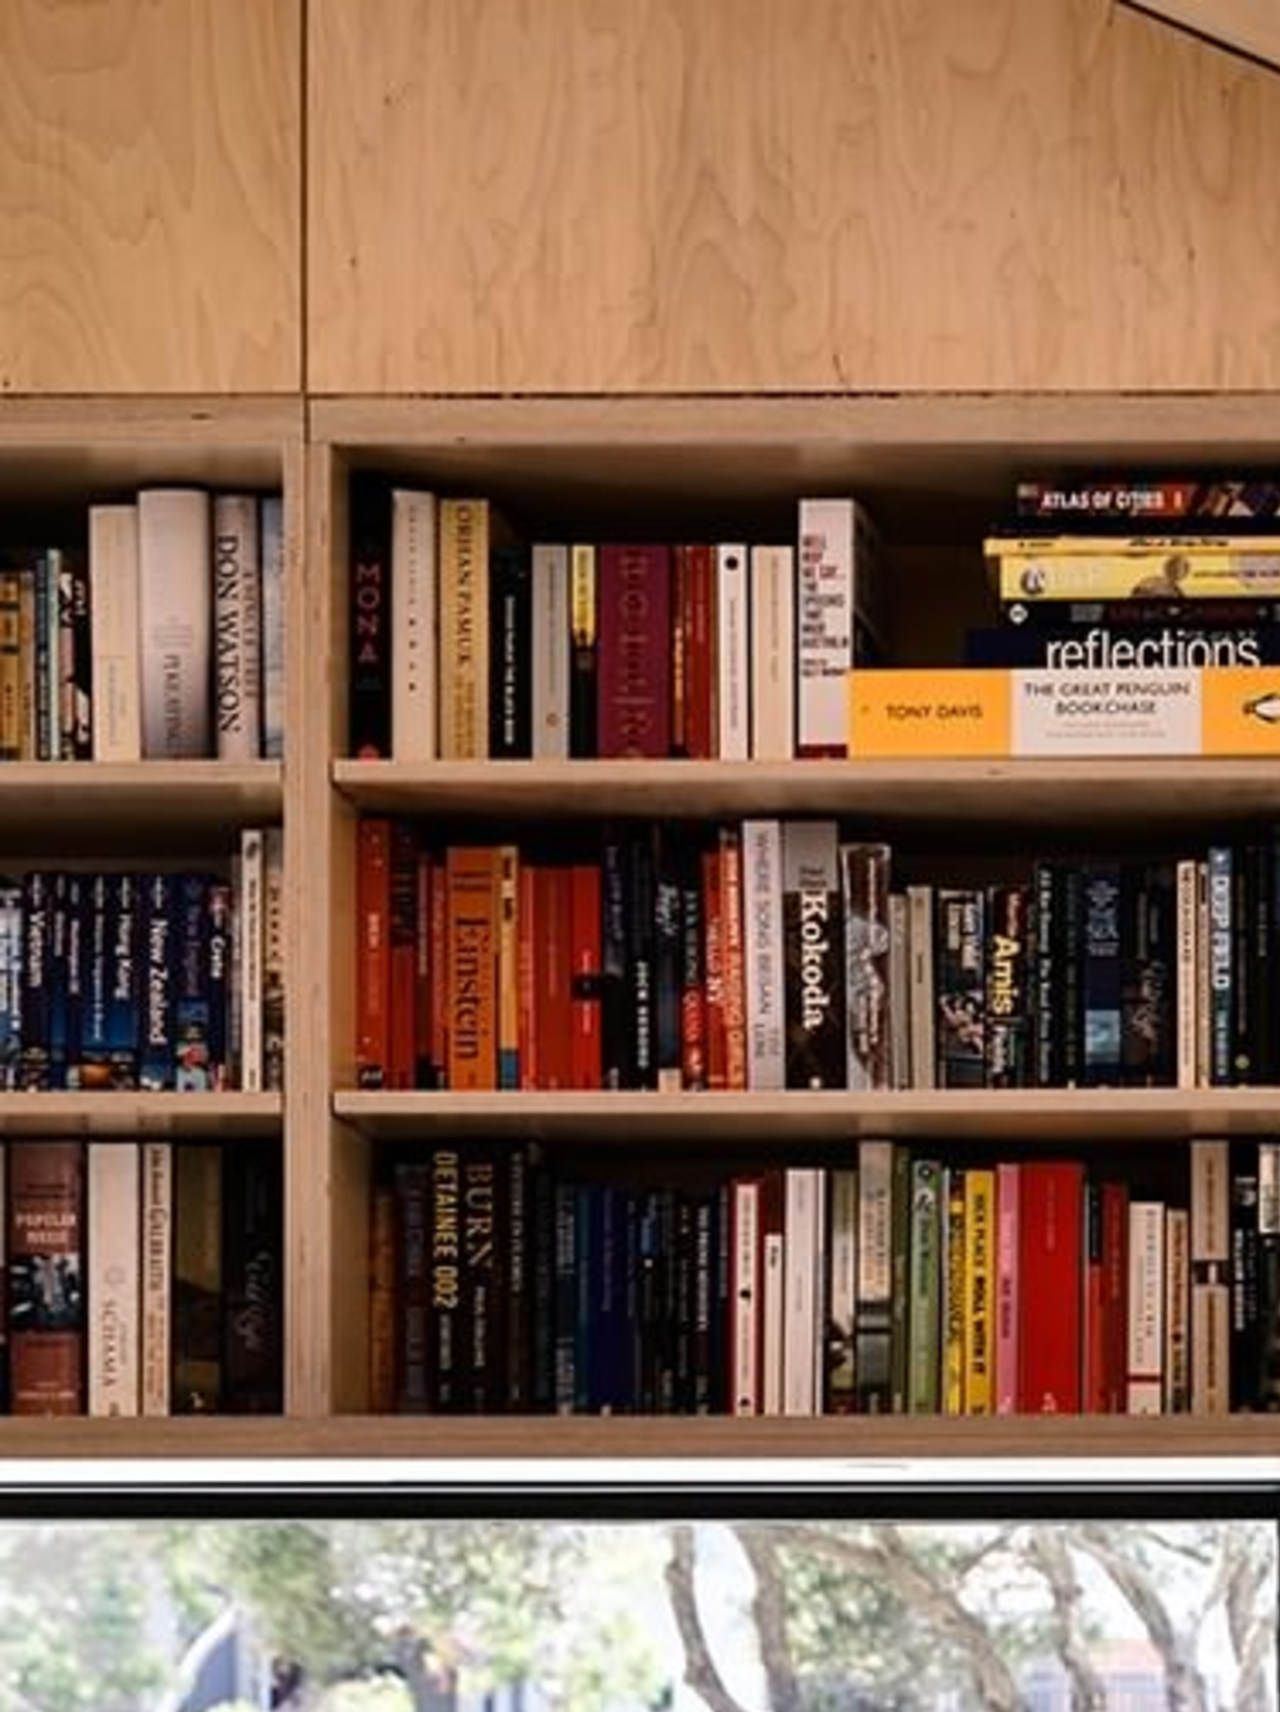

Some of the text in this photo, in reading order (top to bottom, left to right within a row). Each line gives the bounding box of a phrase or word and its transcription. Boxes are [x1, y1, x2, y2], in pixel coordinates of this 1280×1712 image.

[1041, 491, 1085, 509] ATLAS
[456, 506, 472, 585] ORHAN
[218, 534, 240, 733] DON WATSON
[456, 592, 471, 669] PAMUK
[1046, 628, 1261, 669] reflections
[886, 705, 983, 719] TONY DAVIS
[1024, 681, 1191, 697] THE GREAT PENGUIN
[29, 911, 45, 987] Vietnam
[116, 914, 132, 1000] Hong Kong
[800, 892, 829, 1030] Kokoda
[1211, 875, 1230, 989] DEEP FIELD
[148, 918, 168, 1045] New Zealand
[455, 917, 490, 1060] Einstein
[992, 935, 1020, 1014] Amis
[432, 1152, 459, 1309] DETAINEE 002
[466, 1163, 493, 1268] BURN
[972, 1275, 985, 1314] ROLL
[972, 1320, 985, 1351] WITH
